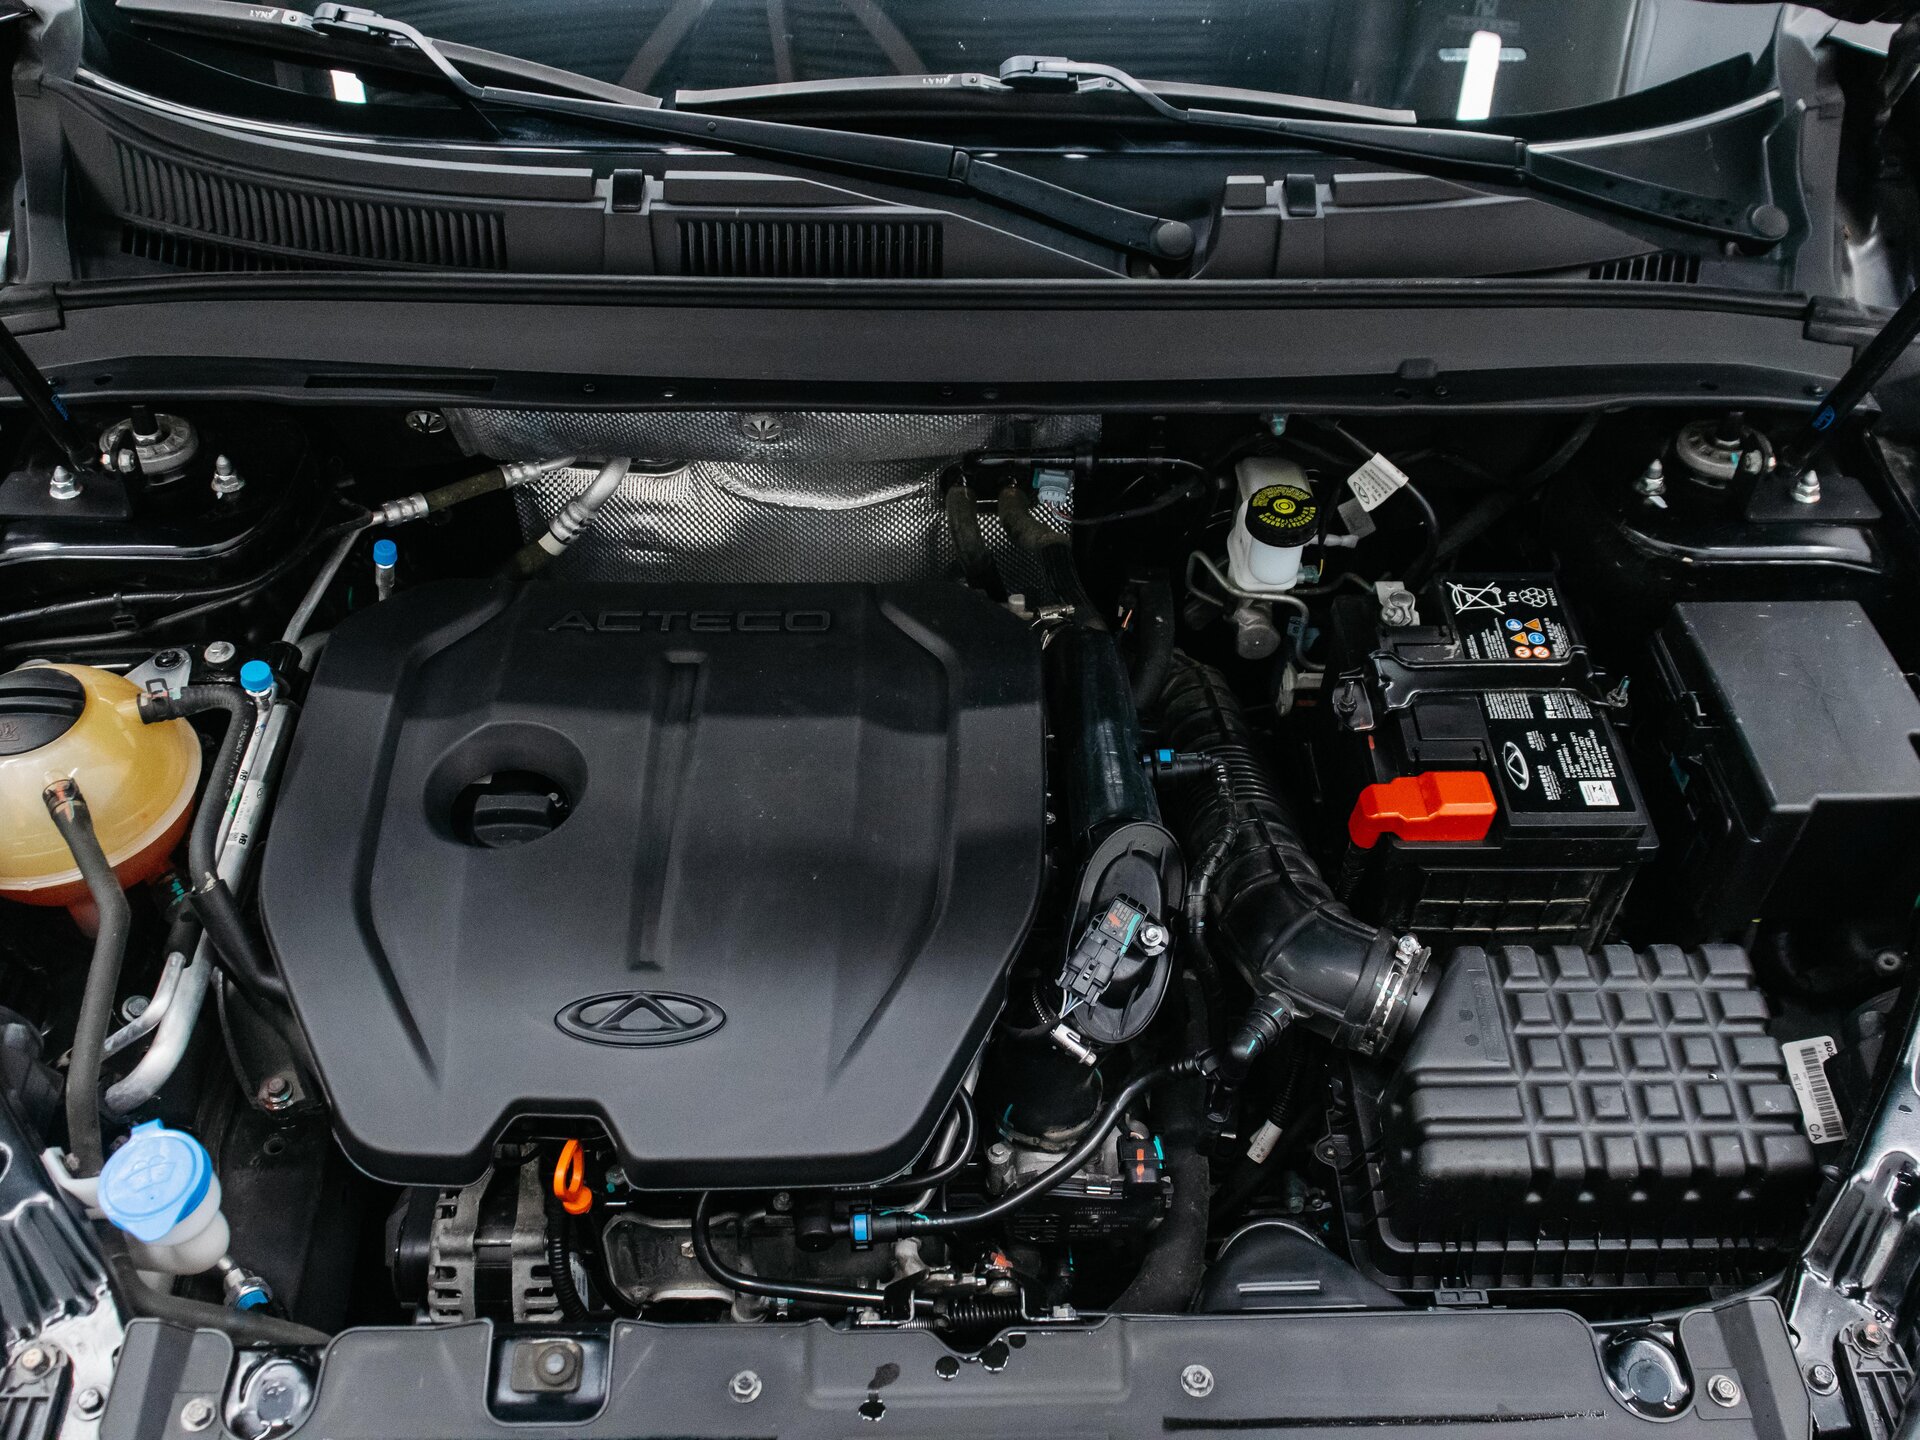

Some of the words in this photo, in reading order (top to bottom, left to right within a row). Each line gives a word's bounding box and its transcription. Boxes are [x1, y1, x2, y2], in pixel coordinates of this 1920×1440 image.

[922, 74, 954, 85] LYNX
[1508, 592, 1518, 602] Pb
[547, 609, 832, 633] ACTECO
[1809, 1123, 1824, 1142] CA
